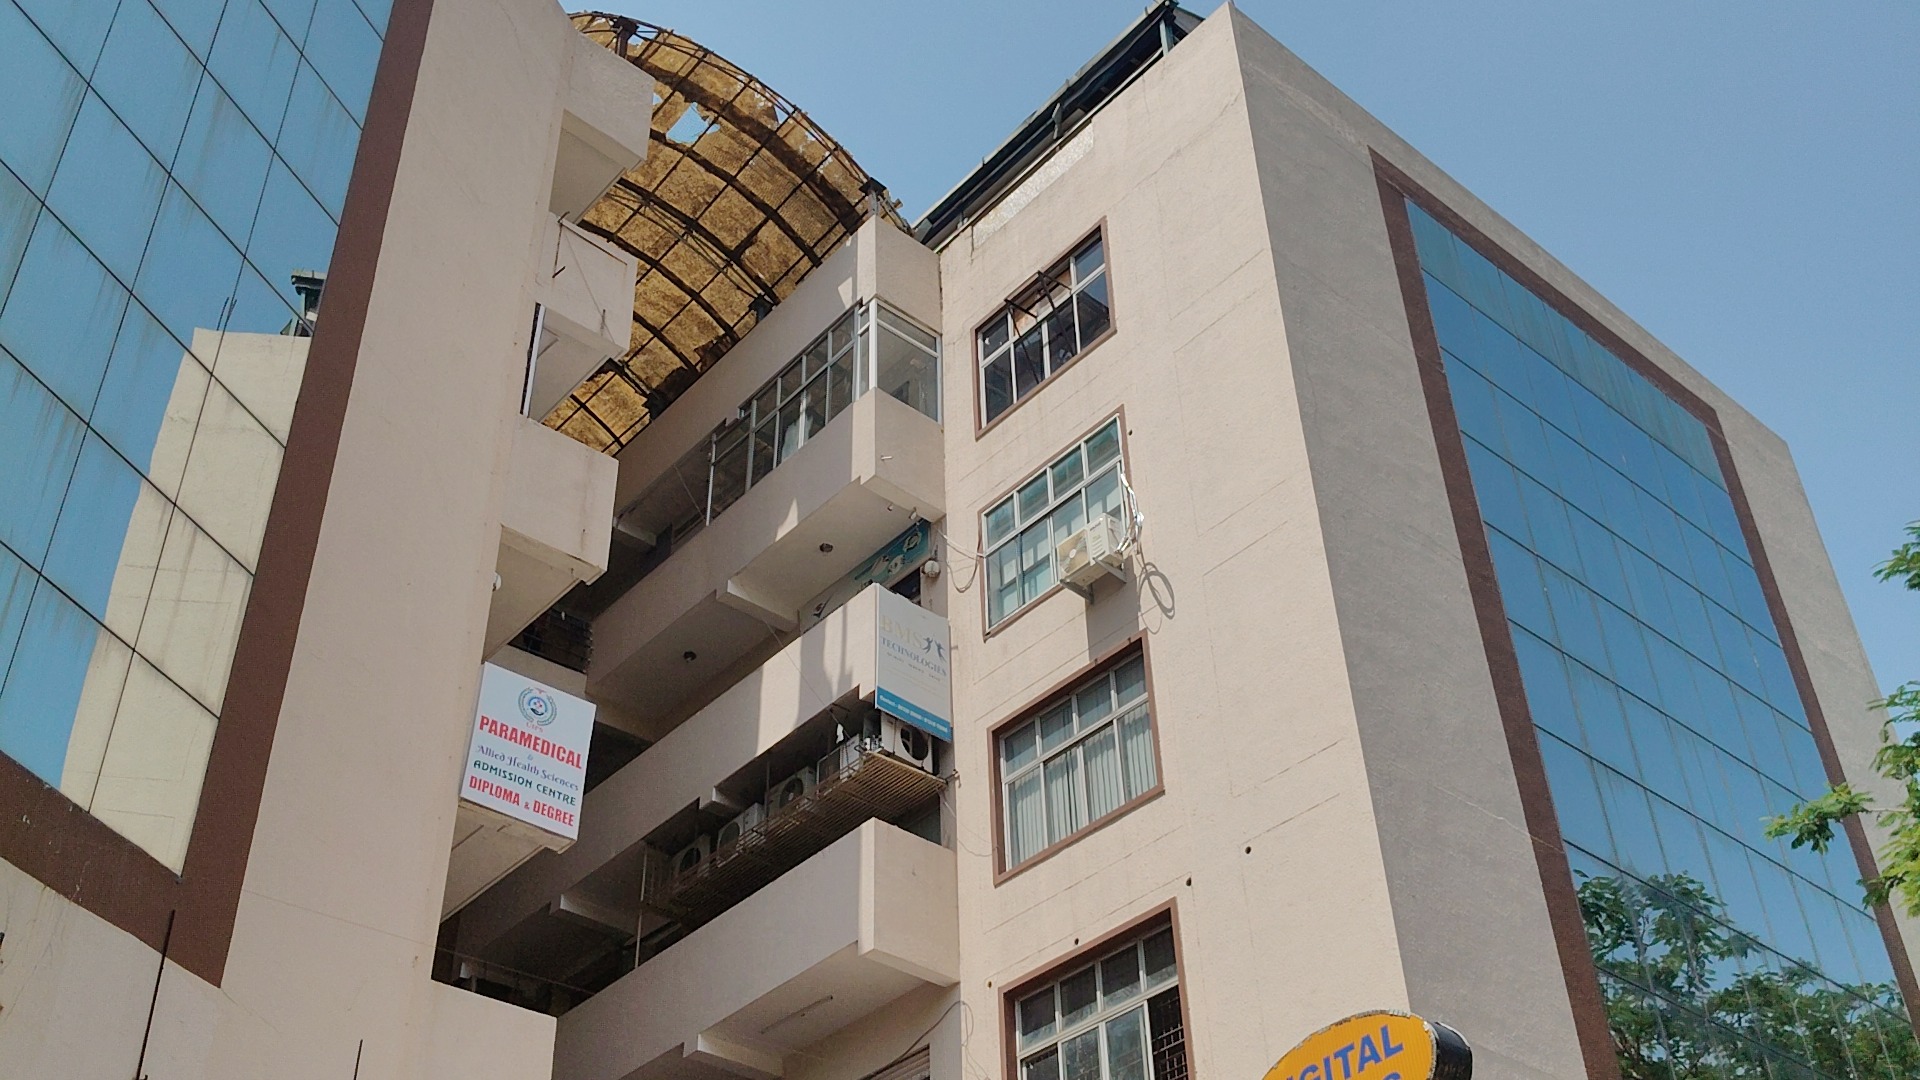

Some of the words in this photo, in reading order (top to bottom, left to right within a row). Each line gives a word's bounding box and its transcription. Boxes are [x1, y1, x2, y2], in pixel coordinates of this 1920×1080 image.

[880, 636, 947, 676] TECHNOLOGIES
[479, 715, 582, 769] PARAMEDICAL
[473, 760, 533, 788] ADMISSION
[536, 784, 576, 806] CENTRE
[476, 744, 505, 761] Allied
[507, 756, 539, 776] Health
[541, 769, 579, 791] Sciences
[469, 775, 520, 806] DIPLOMA
[523, 801, 530, 810] &
[533, 800, 575, 827] DEGREE
[1286, 1024, 1404, 1080] GITAL
